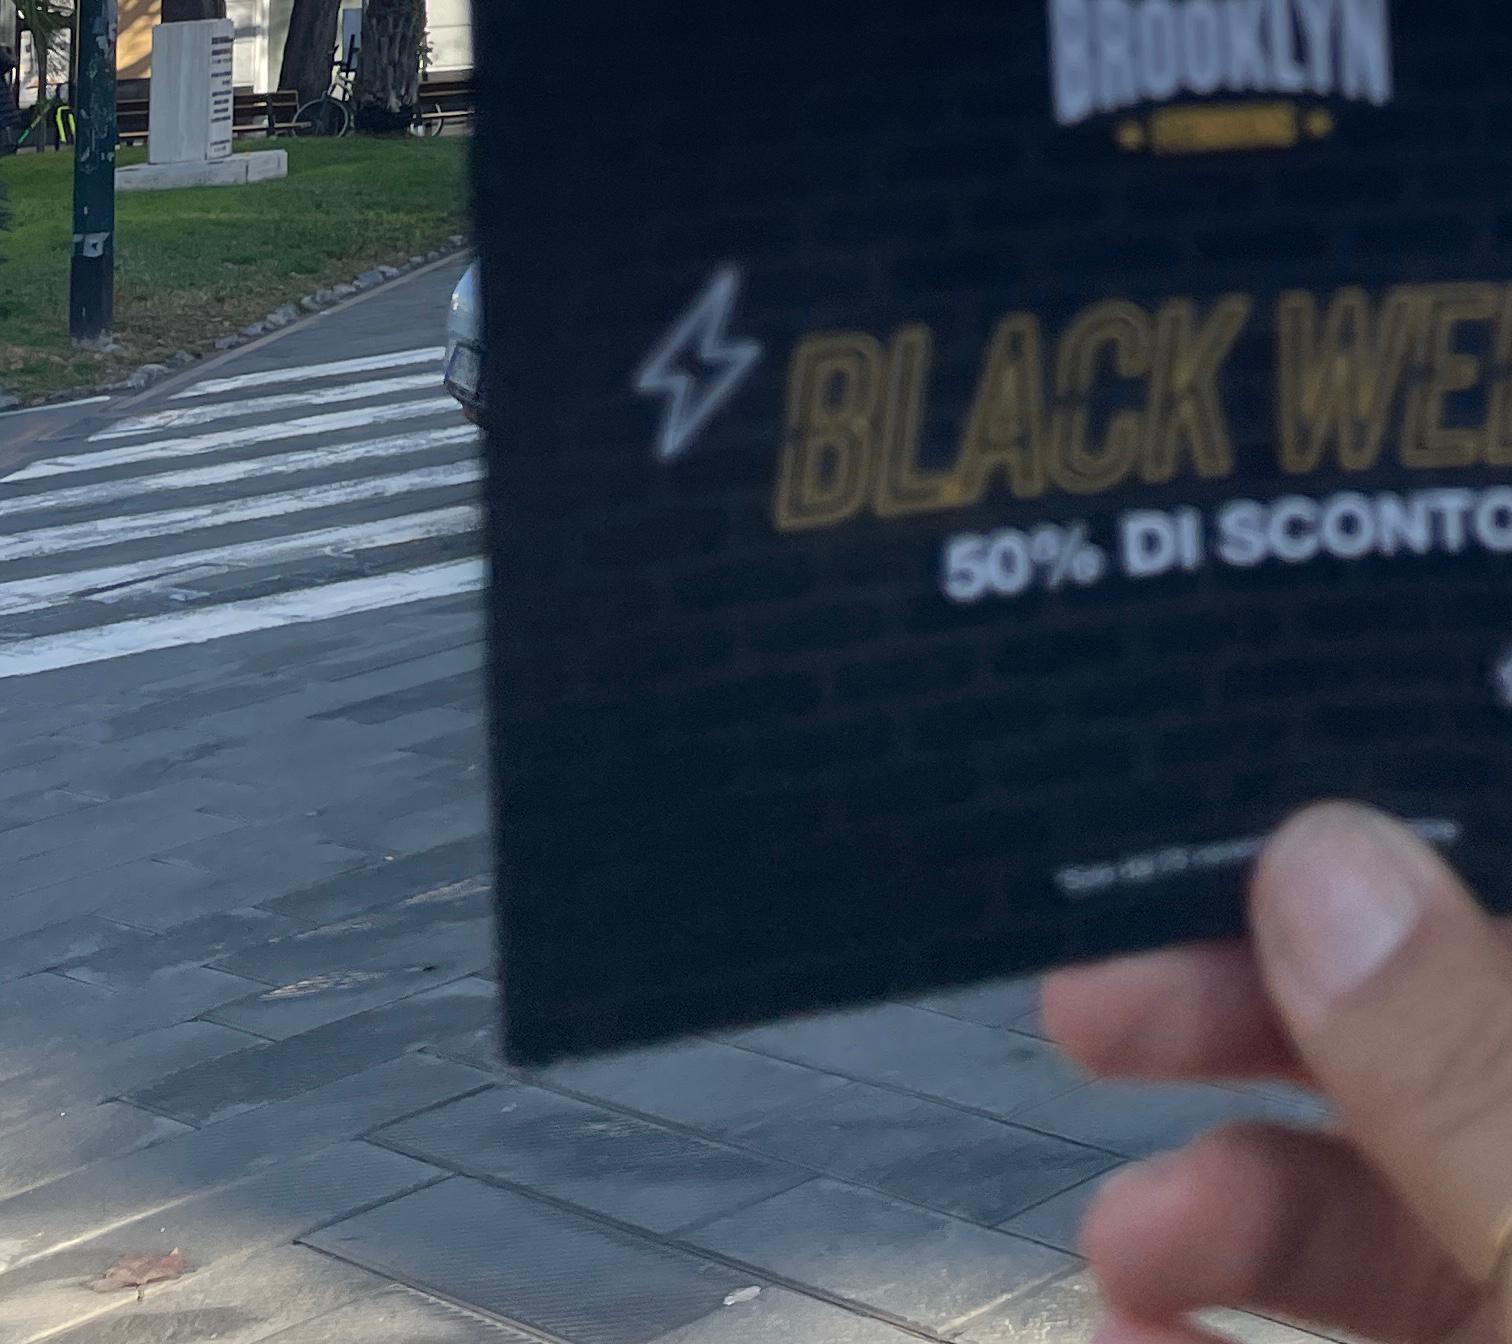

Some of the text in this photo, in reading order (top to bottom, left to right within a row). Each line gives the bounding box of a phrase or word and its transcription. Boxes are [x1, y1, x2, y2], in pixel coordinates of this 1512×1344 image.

[774, 294, 1254, 532] BLACK
[943, 519, 1105, 601] 50%
[1122, 507, 1201, 576] DI
